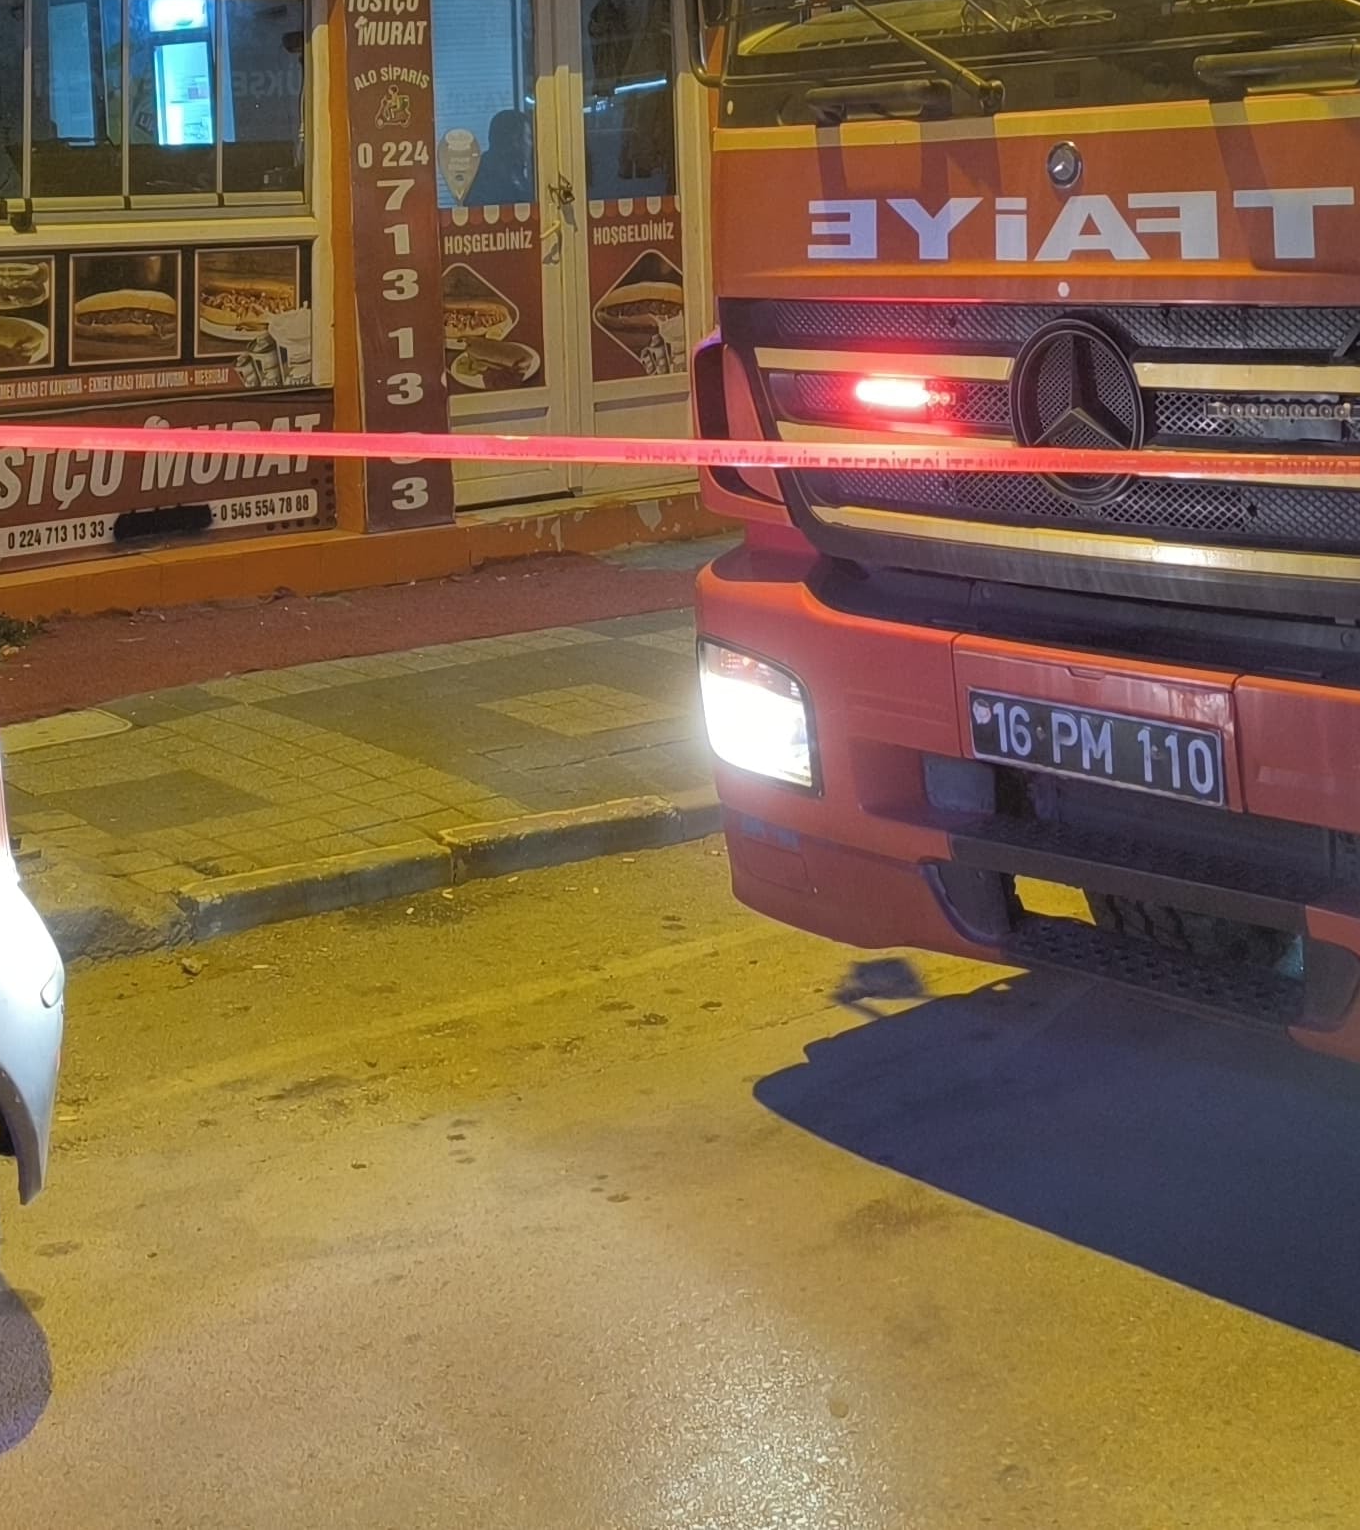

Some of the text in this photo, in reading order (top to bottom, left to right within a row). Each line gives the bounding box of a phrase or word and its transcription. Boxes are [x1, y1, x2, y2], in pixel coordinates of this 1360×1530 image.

[357, 21, 427, 46] MURAT
[354, 70, 377, 91] ALO
[358, 142, 373, 169] 0
[382, 140, 430, 168] 224
[444, 227, 533, 255] HOŞGELDİNİZ
[593, 218, 674, 246] HOŞGELDİNİZ
[17, 381, 38, 399] ARASI
[89, 377, 112, 393] EKMEK
[113, 375, 134, 391] ARASI
[8, 494, 310, 550] 0 224 713 13 33 0 545 554 78 88
[993, 702, 1215, 795] 16 PM 110
